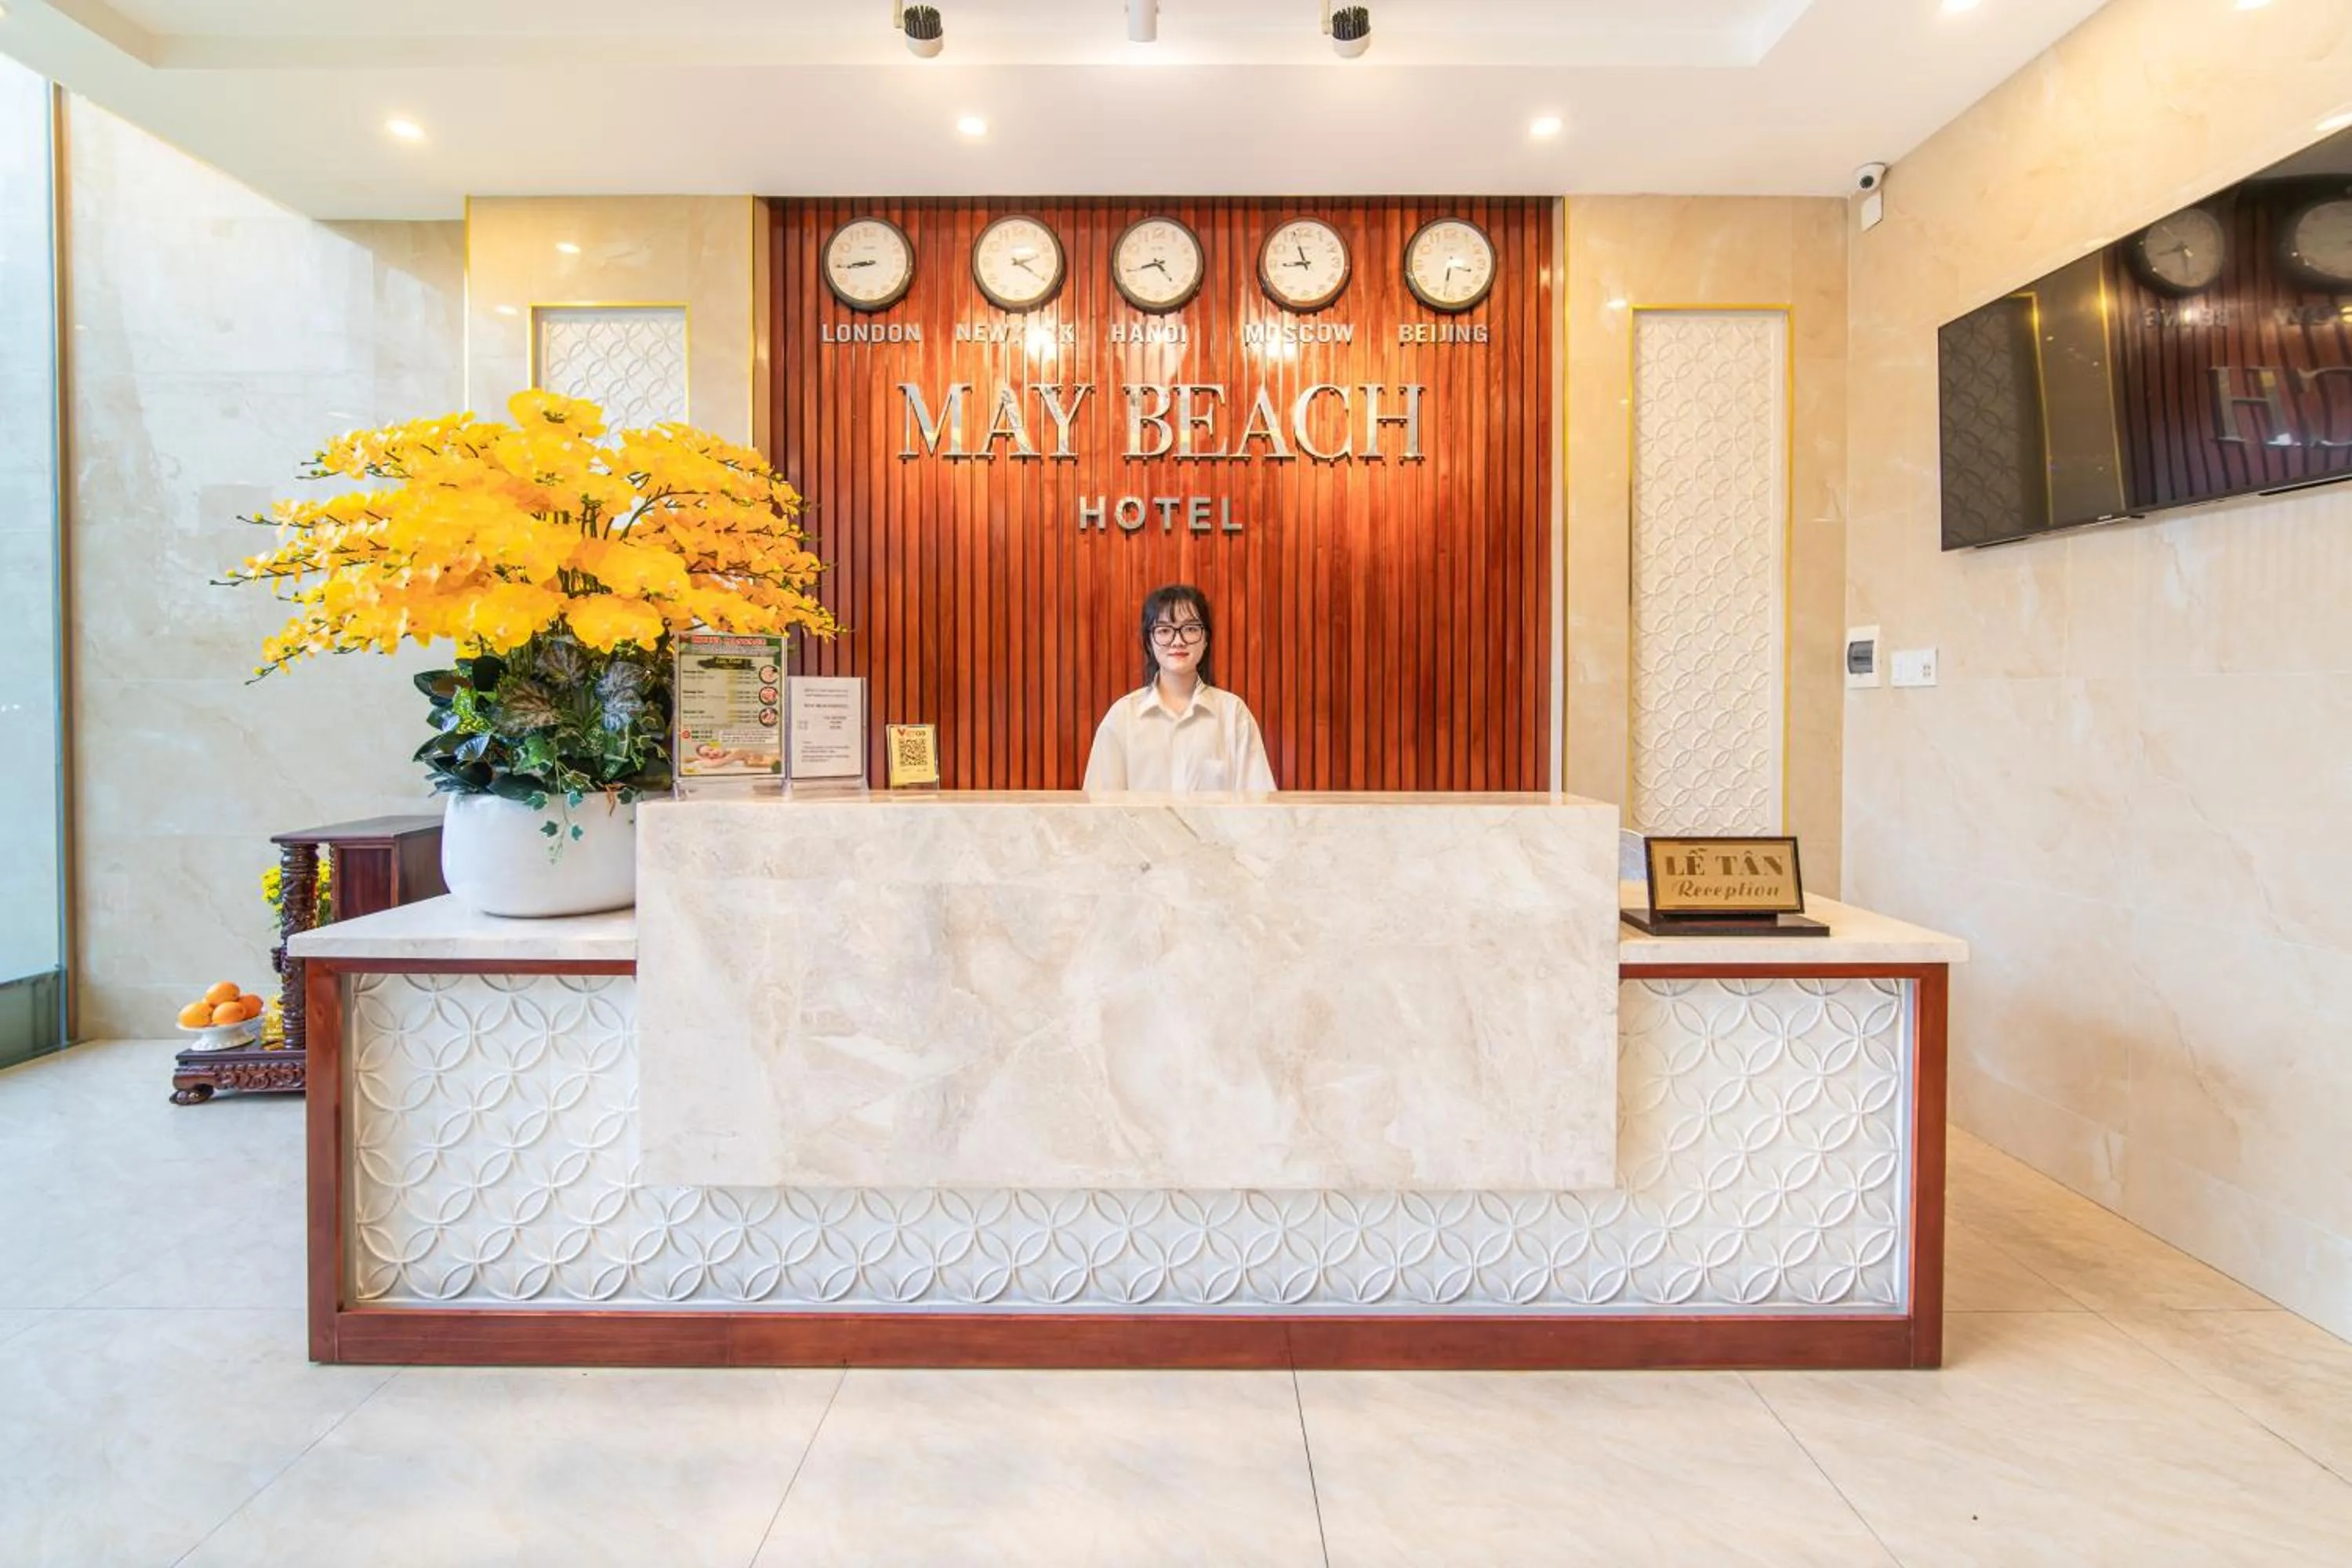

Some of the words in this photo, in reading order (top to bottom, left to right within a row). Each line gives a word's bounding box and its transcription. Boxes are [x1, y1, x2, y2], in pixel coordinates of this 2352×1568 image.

[822, 323, 921, 343] LONDON
[1110, 323, 1187, 343] HANOI
[1245, 323, 1355, 343] MOSCOW
[1398, 323, 1488, 343] BEIJING
[898, 383, 1095, 459] MAY
[1122, 381, 1426, 463] BEACH
[1078, 495, 1243, 532] HOTEL
[1665, 848, 1708, 877] LỄ
[1715, 851, 1784, 877] TÂN
[1671, 880, 1780, 901] Reception
